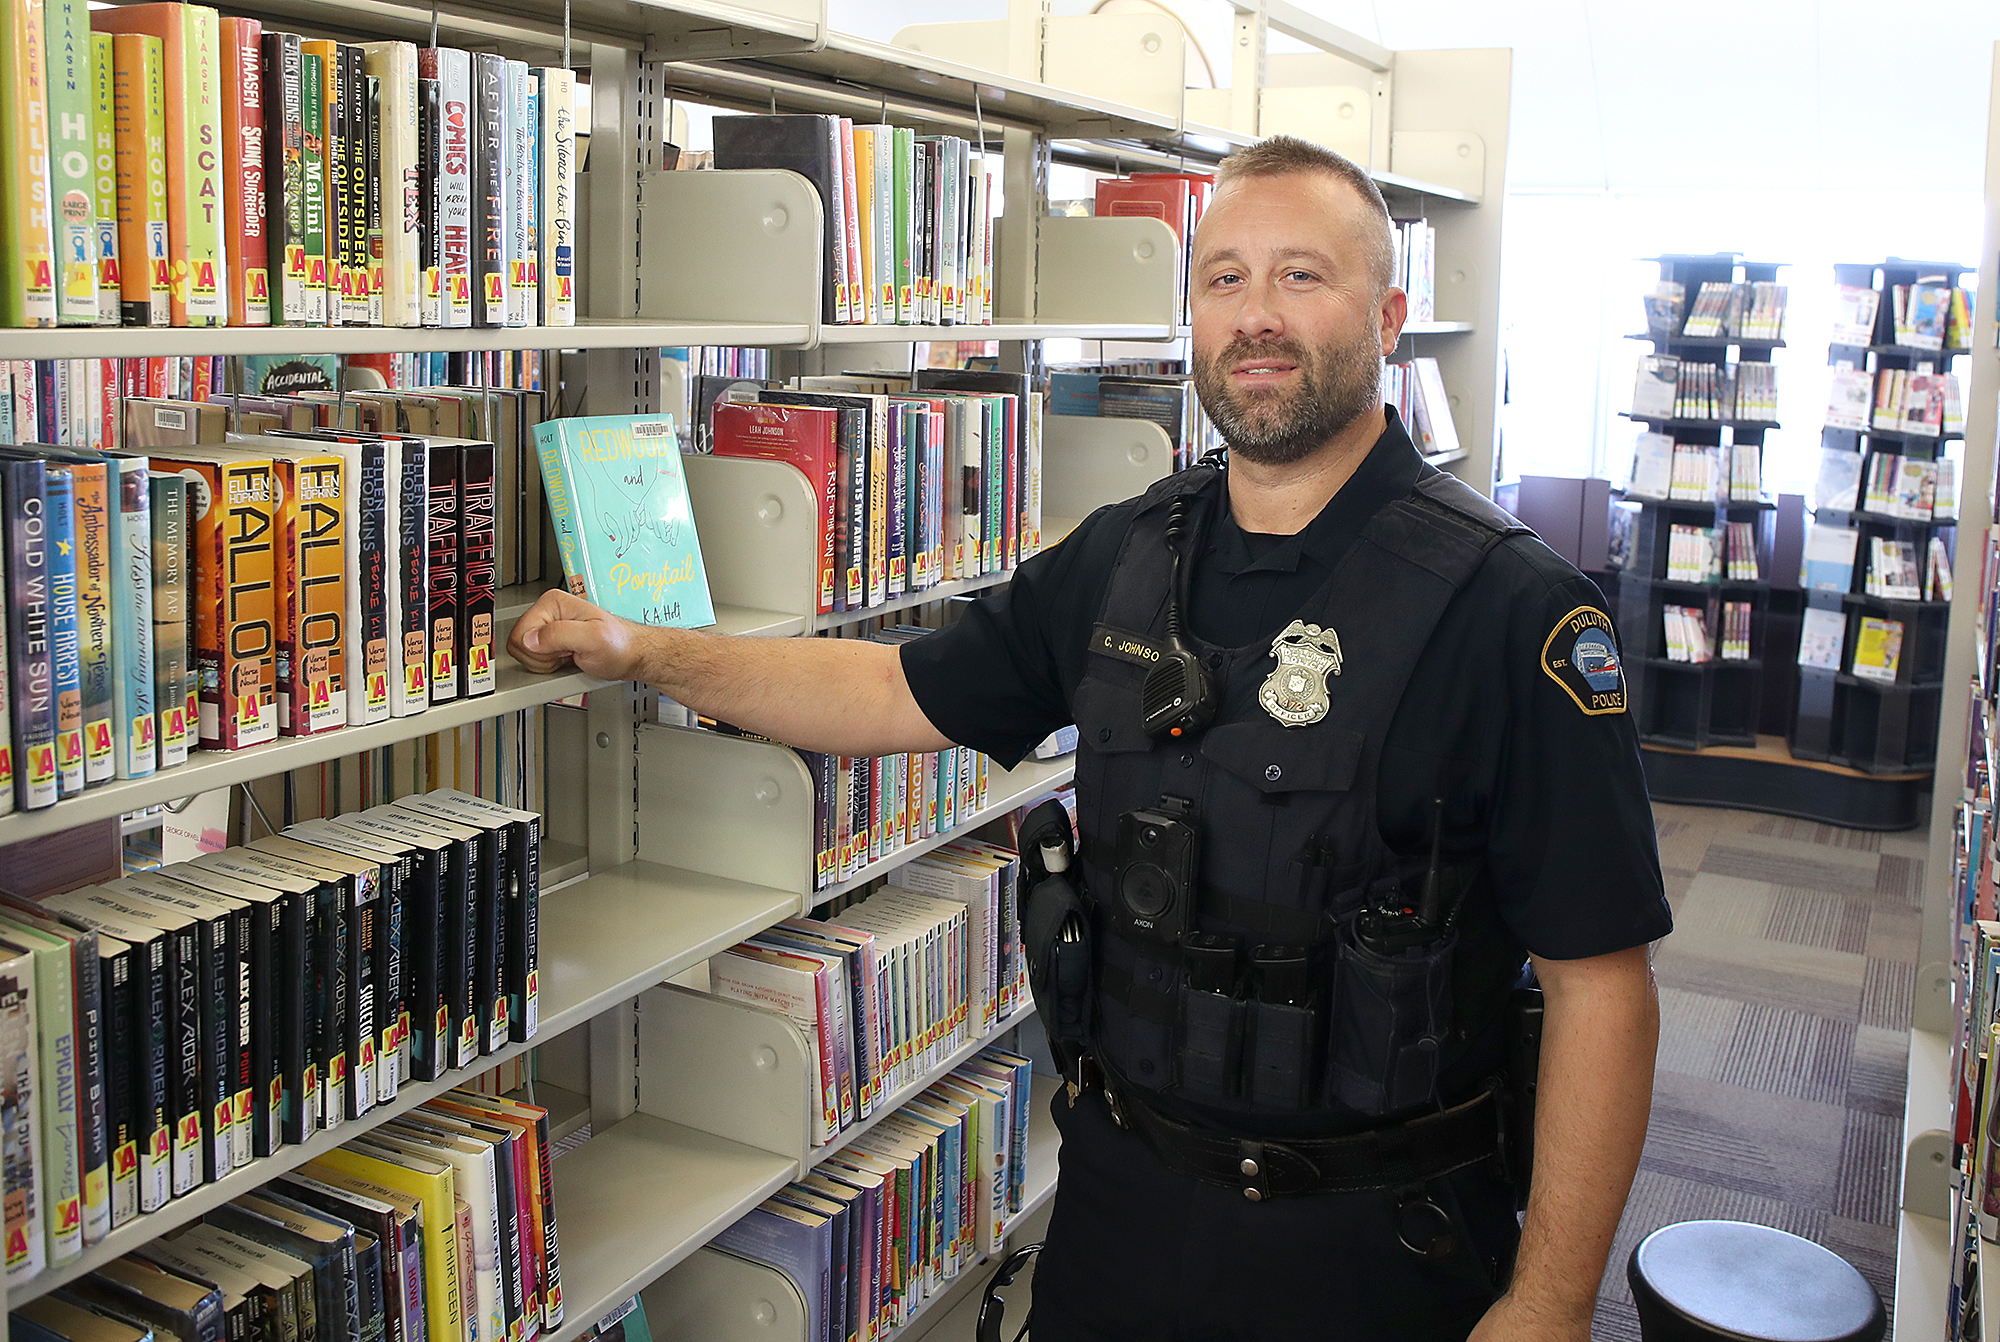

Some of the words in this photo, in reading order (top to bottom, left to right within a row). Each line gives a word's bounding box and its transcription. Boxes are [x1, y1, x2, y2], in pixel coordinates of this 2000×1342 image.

[63, 3, 76, 90] HIAASEN
[199, 16, 209, 105] HIAASEN
[284, 42, 301, 75] JACK
[98, 42, 107, 112] HIAASEN
[240, 46, 260, 109] HIAASEN
[561, 81, 568, 93] HO
[488, 72, 500, 149] AFTER
[558, 107, 570, 133] the
[29, 101, 47, 229] FLUSH
[241, 126, 263, 169] SKINK
[338, 136, 346, 162] THE
[355, 139, 364, 164] THE
[556, 131, 573, 181] Silence
[96, 132, 112, 216] HOOT
[150, 136, 164, 218] HOOT
[198, 124, 215, 224] SCAT
[449, 182, 466, 192] WILL
[490, 158, 498, 187] THE
[62, 200, 88, 209] LARGE
[63, 209, 86, 218] PRINT
[243, 170, 261, 238] SURRENDER
[258, 191, 266, 218] NO
[306, 161, 322, 235] Malini
[404, 165, 420, 234] TEX
[557, 184, 568, 214] that
[487, 196, 501, 260] FIRE
[555, 218, 571, 247] Bin
[190, 261, 215, 287] YA
[267, 370, 325, 389] ACCIDENTAL
[540, 433, 554, 445] HOLT
[578, 427, 668, 463] REDWOOD
[749, 426, 762, 434] LEAH
[762, 427, 785, 436] JOHNSON
[229, 477, 269, 493] ELLEN
[300, 474, 339, 490] ELLEN
[373, 456, 385, 511] ELLEN
[413, 452, 424, 506] ELLEN
[624, 465, 644, 487] and
[827, 470, 837, 502] RISE
[854, 457, 864, 485] THIS
[167, 488, 179, 518] THE
[229, 492, 270, 504] HOPKINS
[300, 489, 340, 501] HOPKINS
[362, 467, 376, 552] HOPKINS
[402, 462, 415, 546] HOPKINS
[829, 503, 836, 515] TO
[853, 487, 863, 501] IS
[58, 502, 68, 527] HOLT
[541, 449, 570, 518] REDWOOD
[560, 536, 577, 578] Pony
[827, 514, 835, 531] THE
[853, 503, 863, 524] MY
[24, 497, 43, 568] COLD
[429, 478, 457, 611] TRAFFICK
[466, 476, 495, 607] TRAFFICK
[823, 530, 836, 558] SUN
[852, 524, 863, 568] AMERI
[167, 520, 179, 587] MEMORY
[370, 549, 384, 610] PEOPLE
[409, 545, 420, 604] PEOPLE
[609, 553, 696, 602] Ponytail
[27, 575, 48, 655] WHITE
[53, 572, 77, 626] HOUSE
[166, 588, 177, 616] JAR
[371, 617, 382, 641] KIL
[410, 610, 420, 632] KIL
[435, 622, 453, 633] Verse
[435, 633, 453, 644] Novel
[474, 619, 491, 631] Verse
[474, 629, 491, 641] Novel
[1570, 613, 1610, 633] DULUTH
[55, 628, 79, 687] ARREST
[368, 647, 385, 658] Verse
[406, 648, 423, 659] Novel
[407, 637, 423, 648] Verse
[1104, 636, 1114, 648] C.
[1118, 640, 1161, 663] JOHNSO
[308, 665, 327, 676] Novel
[368, 658, 385, 668] Novel
[472, 676, 491, 687] Hopkins
[1284, 655, 1326, 672] POLICE
[1552, 658, 1568, 669] EST.
[29, 661, 50, 713] SUN
[239, 679, 258, 690] Novel
[405, 696, 425, 705] Hopkins
[434, 681, 453, 691] Hopkins
[1591, 693, 1622, 708] POLICE
[368, 706, 387, 714] Hopkins
[1269, 702, 1312, 720] OFFICER
[1282, 699, 1305, 712] 472
[467, 867, 478, 908] ALEX
[529, 850, 538, 891] ALEX
[389, 892, 402, 950] ALEX
[529, 909, 538, 960] RIDER
[1134, 918, 1153, 929] AXON
[336, 914, 348, 968] ALEX
[465, 919, 477, 983] RIDER
[181, 966, 196, 1018] ALEX
[214, 951, 226, 1005] ALEX
[239, 961, 250, 1001] ALEX
[388, 949, 402, 1003] RIDER
[151, 973, 165, 1029] ALEX
[336, 968, 347, 1028] RIDER
[730, 987, 752, 997] PLAYING
[754, 992, 768, 1000] WITH
[770, 996, 795, 1008] MATCHES
[855, 985, 867, 1031] ALMOST
[86, 1008, 98, 1077] POINT
[239, 1001, 251, 1048] RIDER
[823, 1006, 833, 1053] almost
[182, 1021, 198, 1087] RIDER
[214, 1019, 227, 1081] RIDER
[857, 1032, 870, 1081] AUTUMN
[55, 1033, 74, 1113] EPICALLY
[157, 1042, 166, 1108] RIDER
[240, 1051, 249, 1088] POINT
[822, 1056, 835, 1086] perf
[90, 1083, 102, 1155] BLANK
[936, 1175, 945, 1214] PICK-UP
[993, 1169, 1005, 1211] RUN
[407, 1268, 419, 1311] HOWE
[444, 1237, 459, 1326] THIRTEEN
